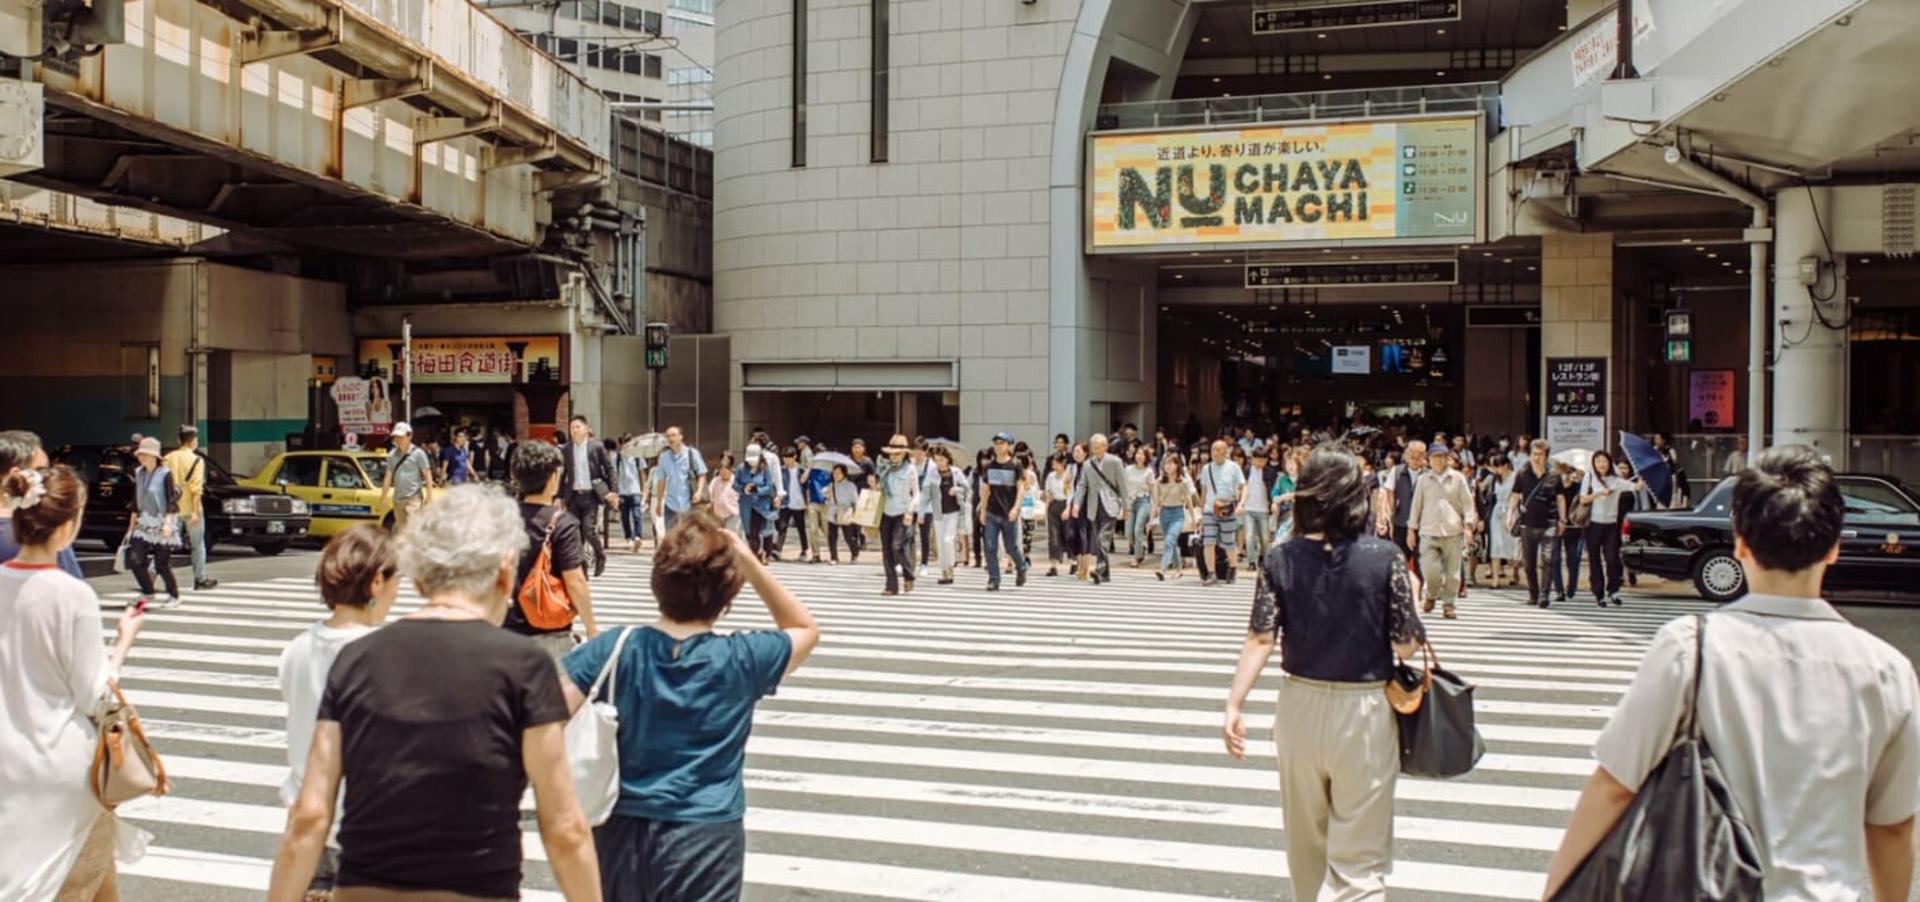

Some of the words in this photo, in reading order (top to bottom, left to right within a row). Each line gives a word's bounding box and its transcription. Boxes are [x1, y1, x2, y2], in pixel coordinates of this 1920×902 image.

[1157, 141, 1326, 160] 近道より、寄り道が楽しい。
[1234, 159, 1367, 194] CHAYA
[1119, 164, 1226, 230] NU
[1234, 191, 1367, 225] MACHI
[1558, 363, 1596, 372] 12F/13F
[1552, 404, 1600, 413] ダイニング
